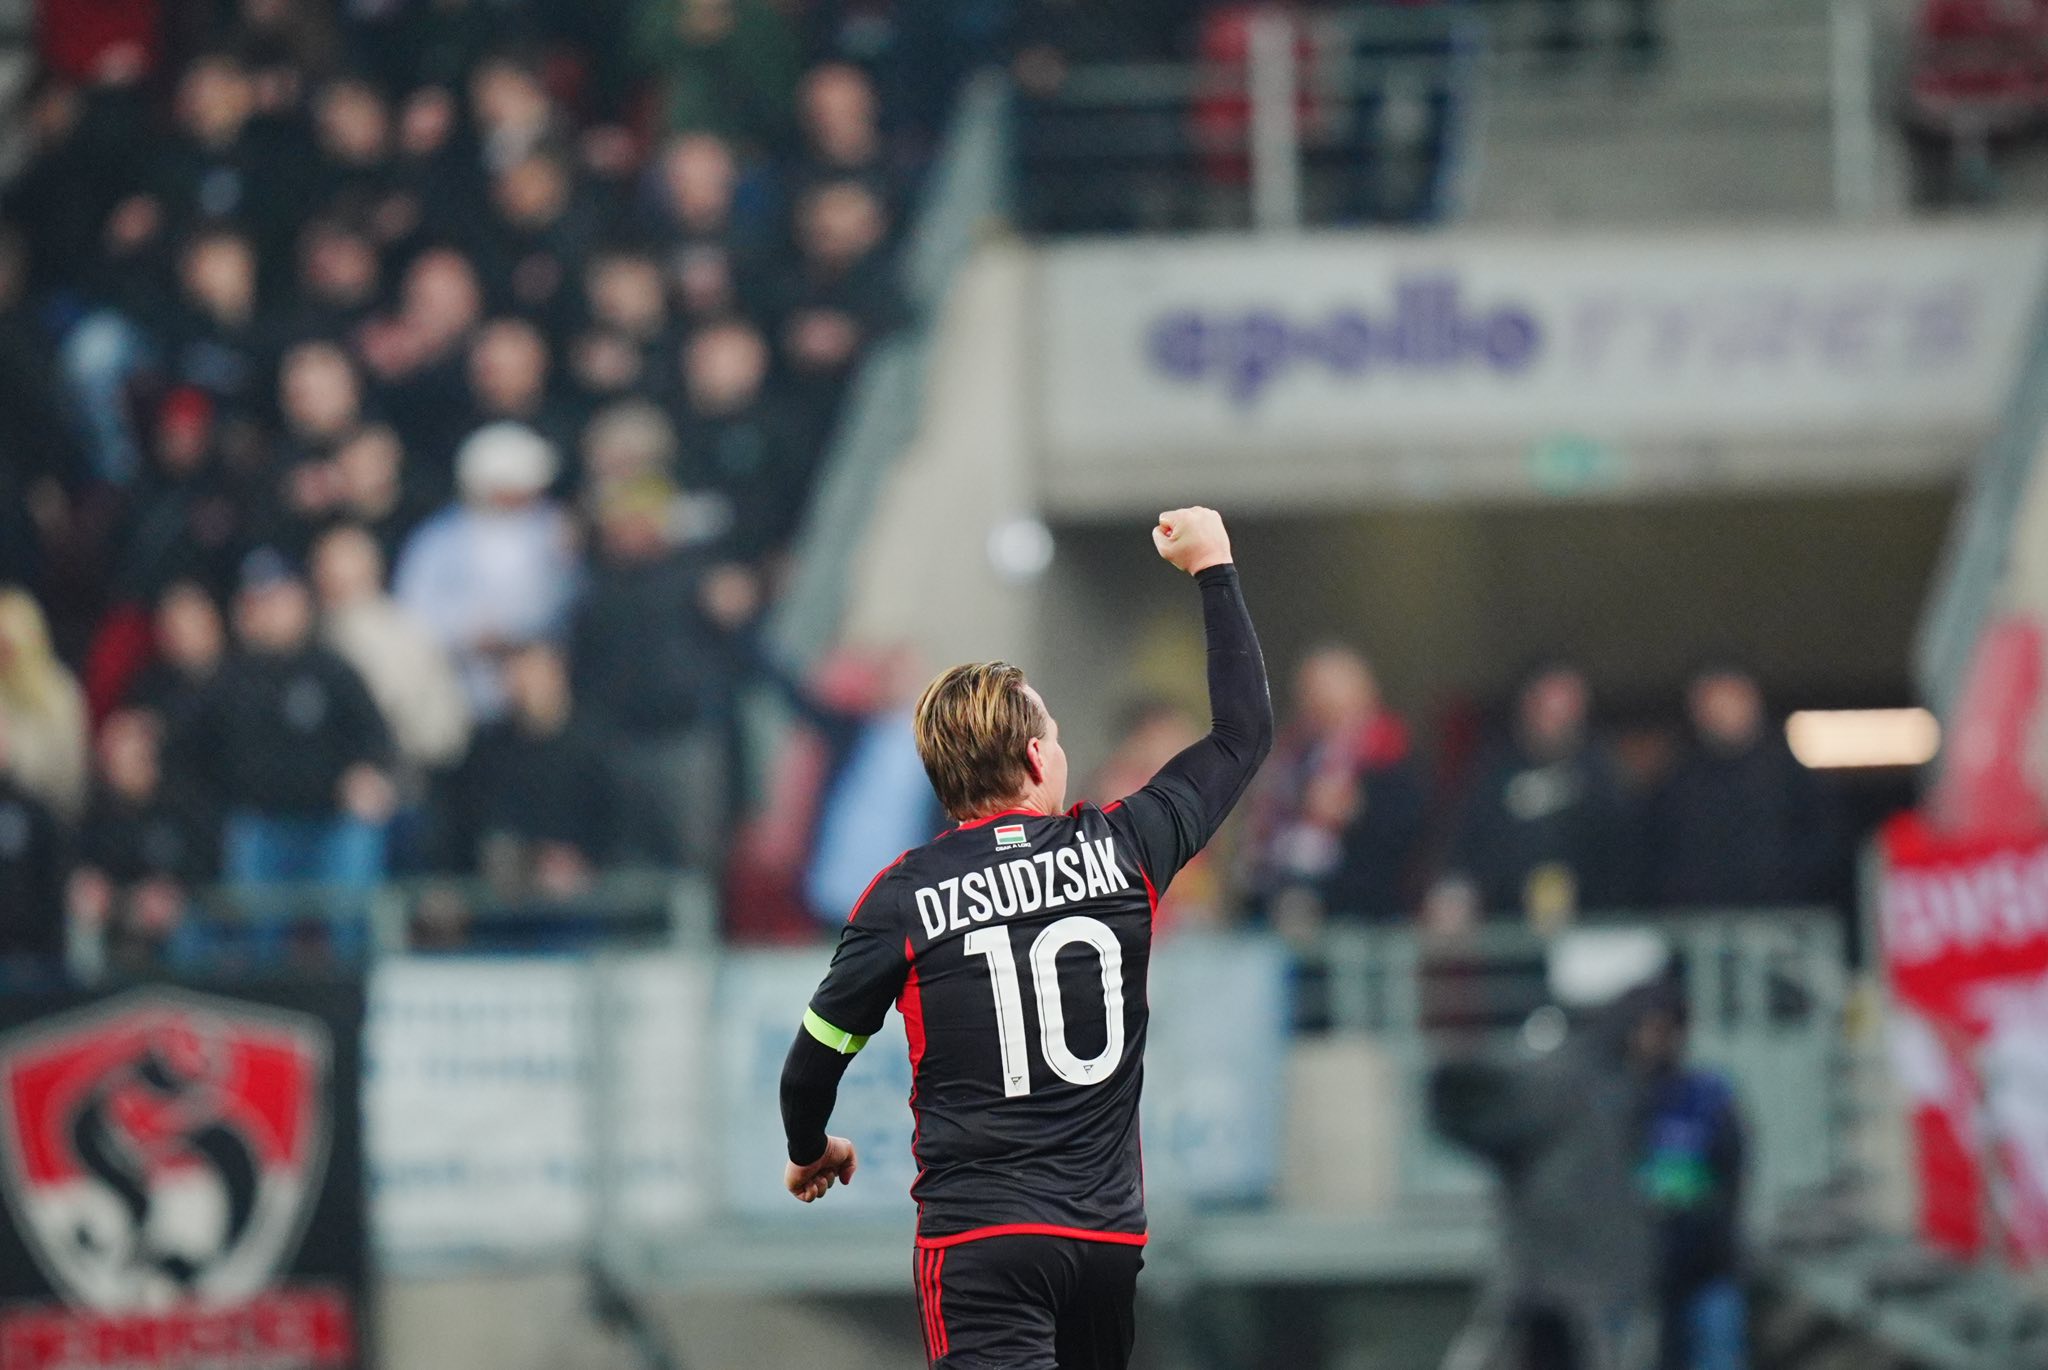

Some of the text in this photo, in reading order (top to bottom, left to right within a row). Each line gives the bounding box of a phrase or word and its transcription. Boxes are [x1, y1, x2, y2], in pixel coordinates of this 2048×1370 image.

[1148, 276, 1545, 410] apollo
[915, 831, 1129, 940] DZSUDZSÁK
[963, 915, 1124, 1098] 10
